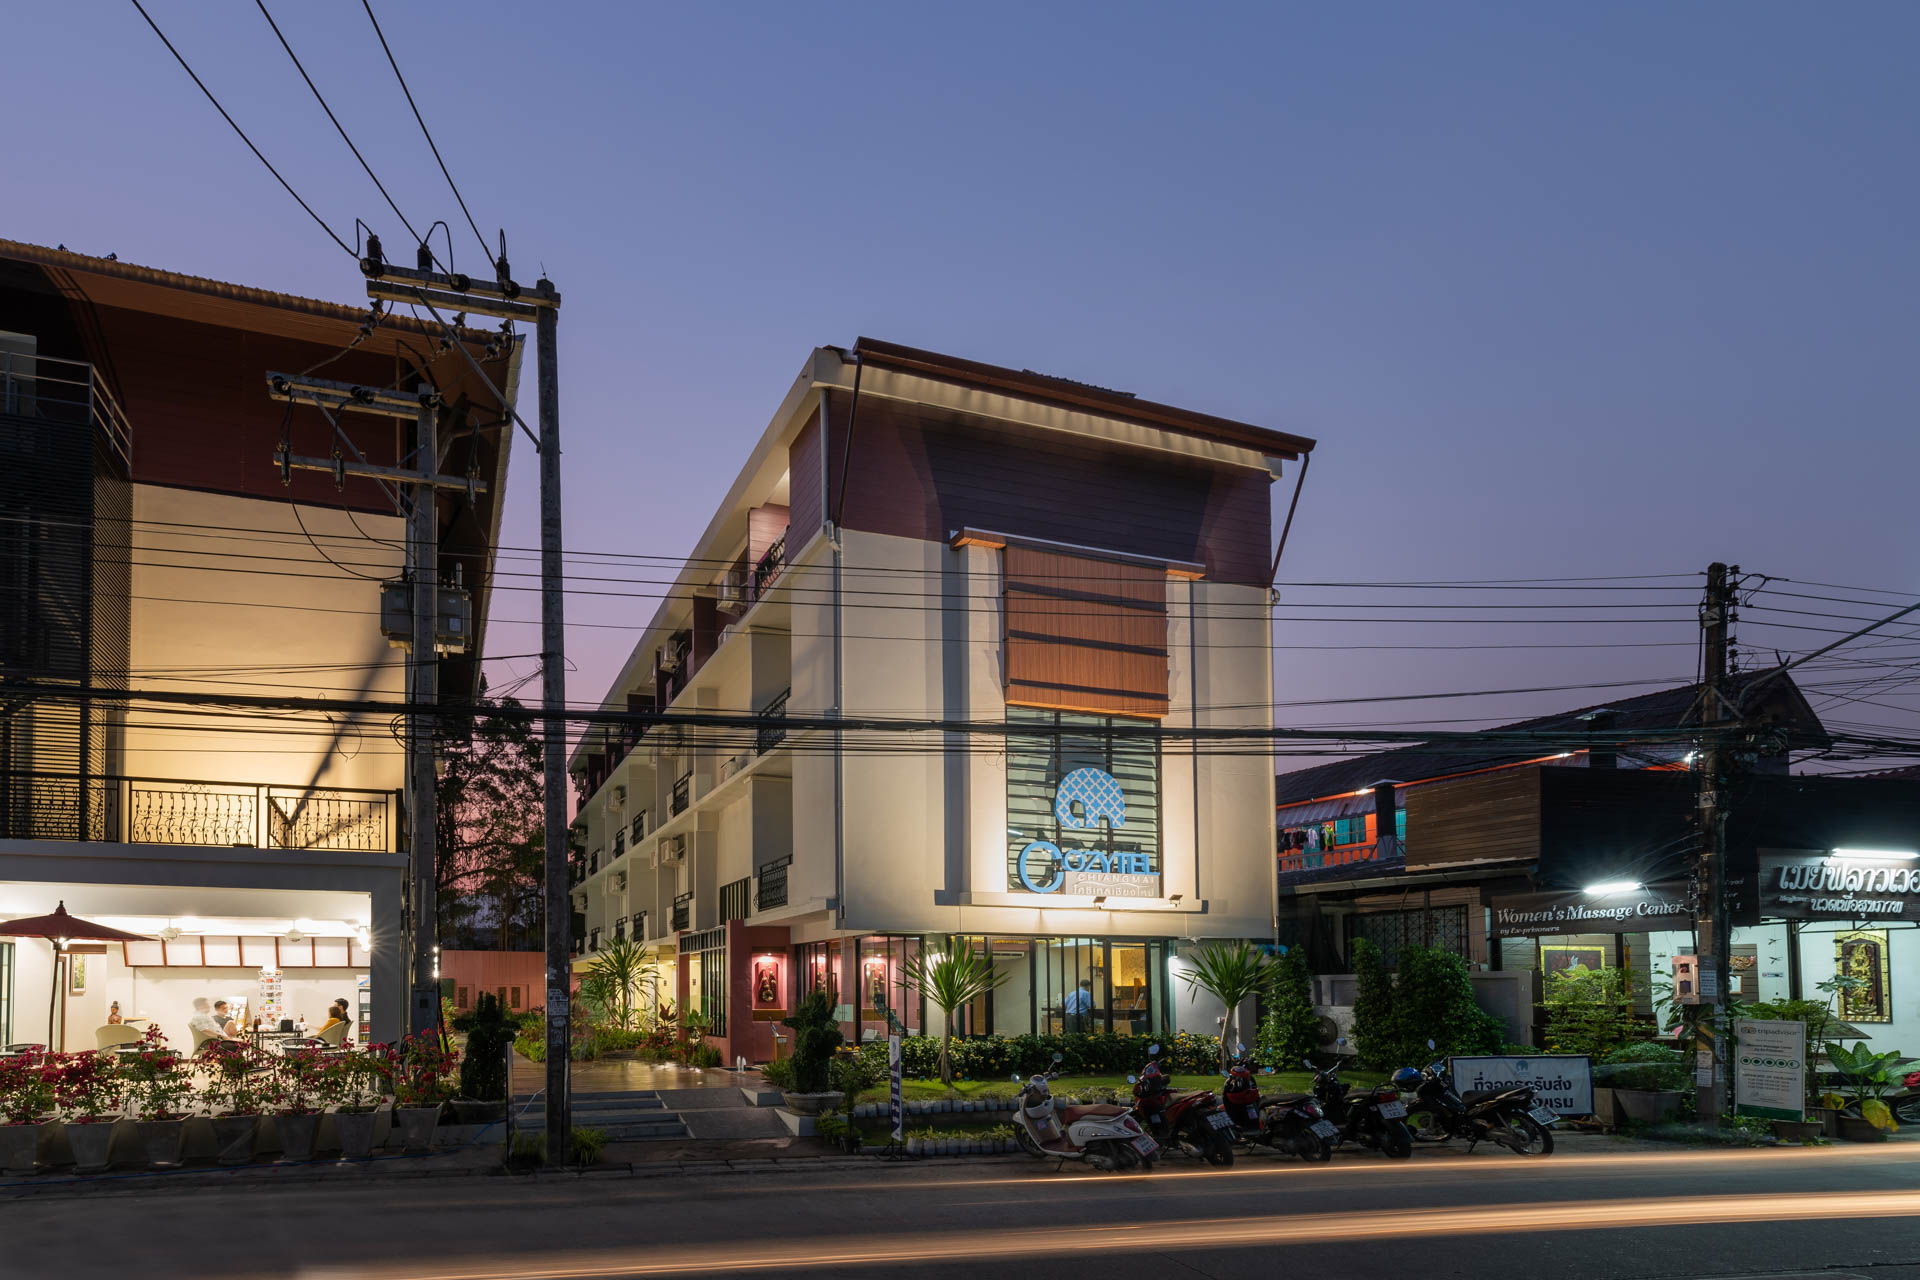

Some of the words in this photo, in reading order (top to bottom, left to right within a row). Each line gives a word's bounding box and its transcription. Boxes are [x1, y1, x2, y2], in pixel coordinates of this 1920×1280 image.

[1498, 904, 1564, 924] Women's
[1566, 904, 1633, 921] Massage
[1636, 901, 1684, 916] Center
